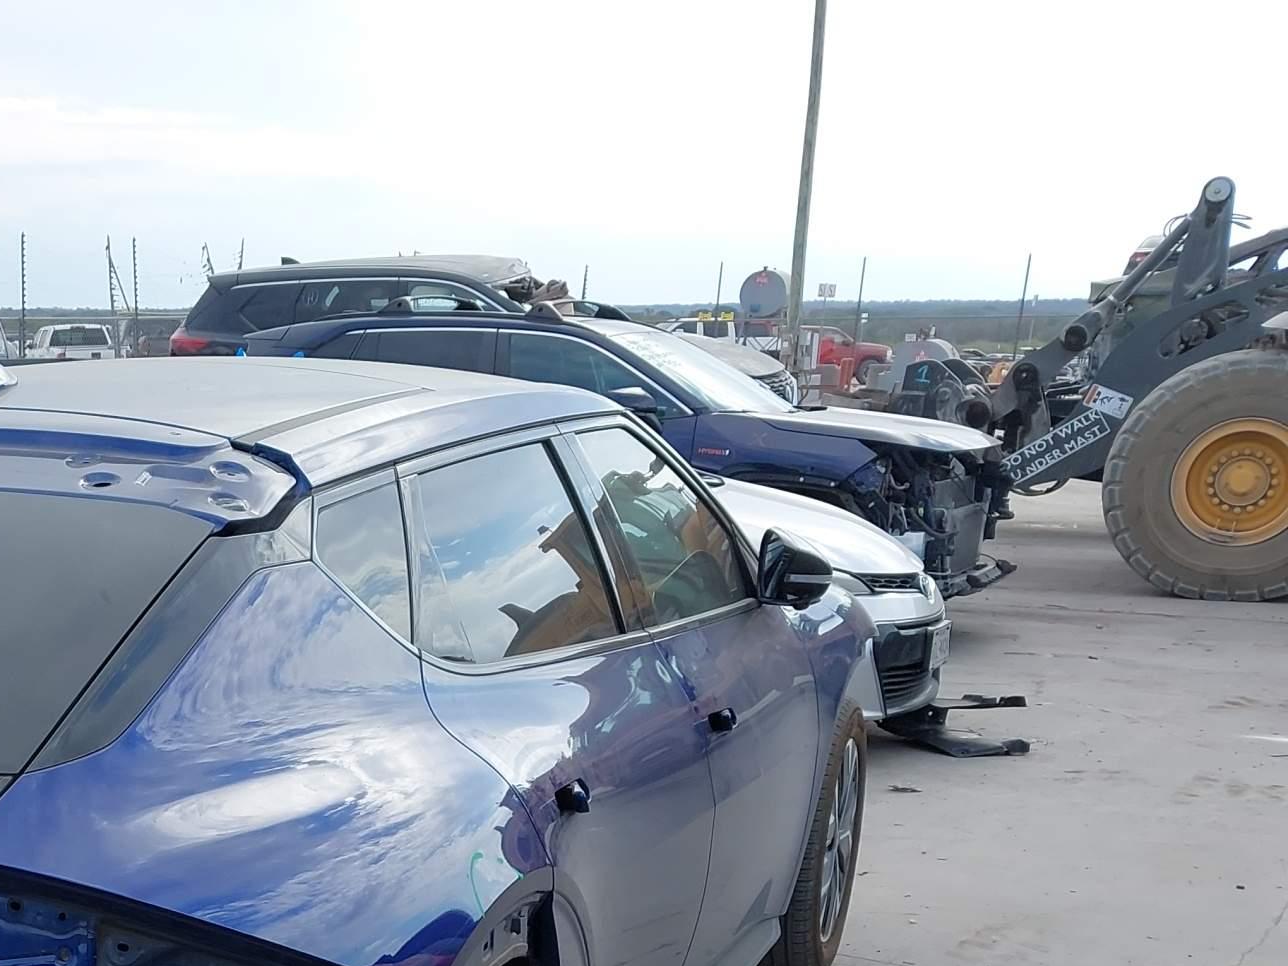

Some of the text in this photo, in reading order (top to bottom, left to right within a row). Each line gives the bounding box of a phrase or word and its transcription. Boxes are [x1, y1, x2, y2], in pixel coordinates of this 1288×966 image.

[1010, 425, 1101, 480] UNDER MAST
[1024, 433, 1054, 459] NOT
[1056, 409, 1100, 438] WALK
